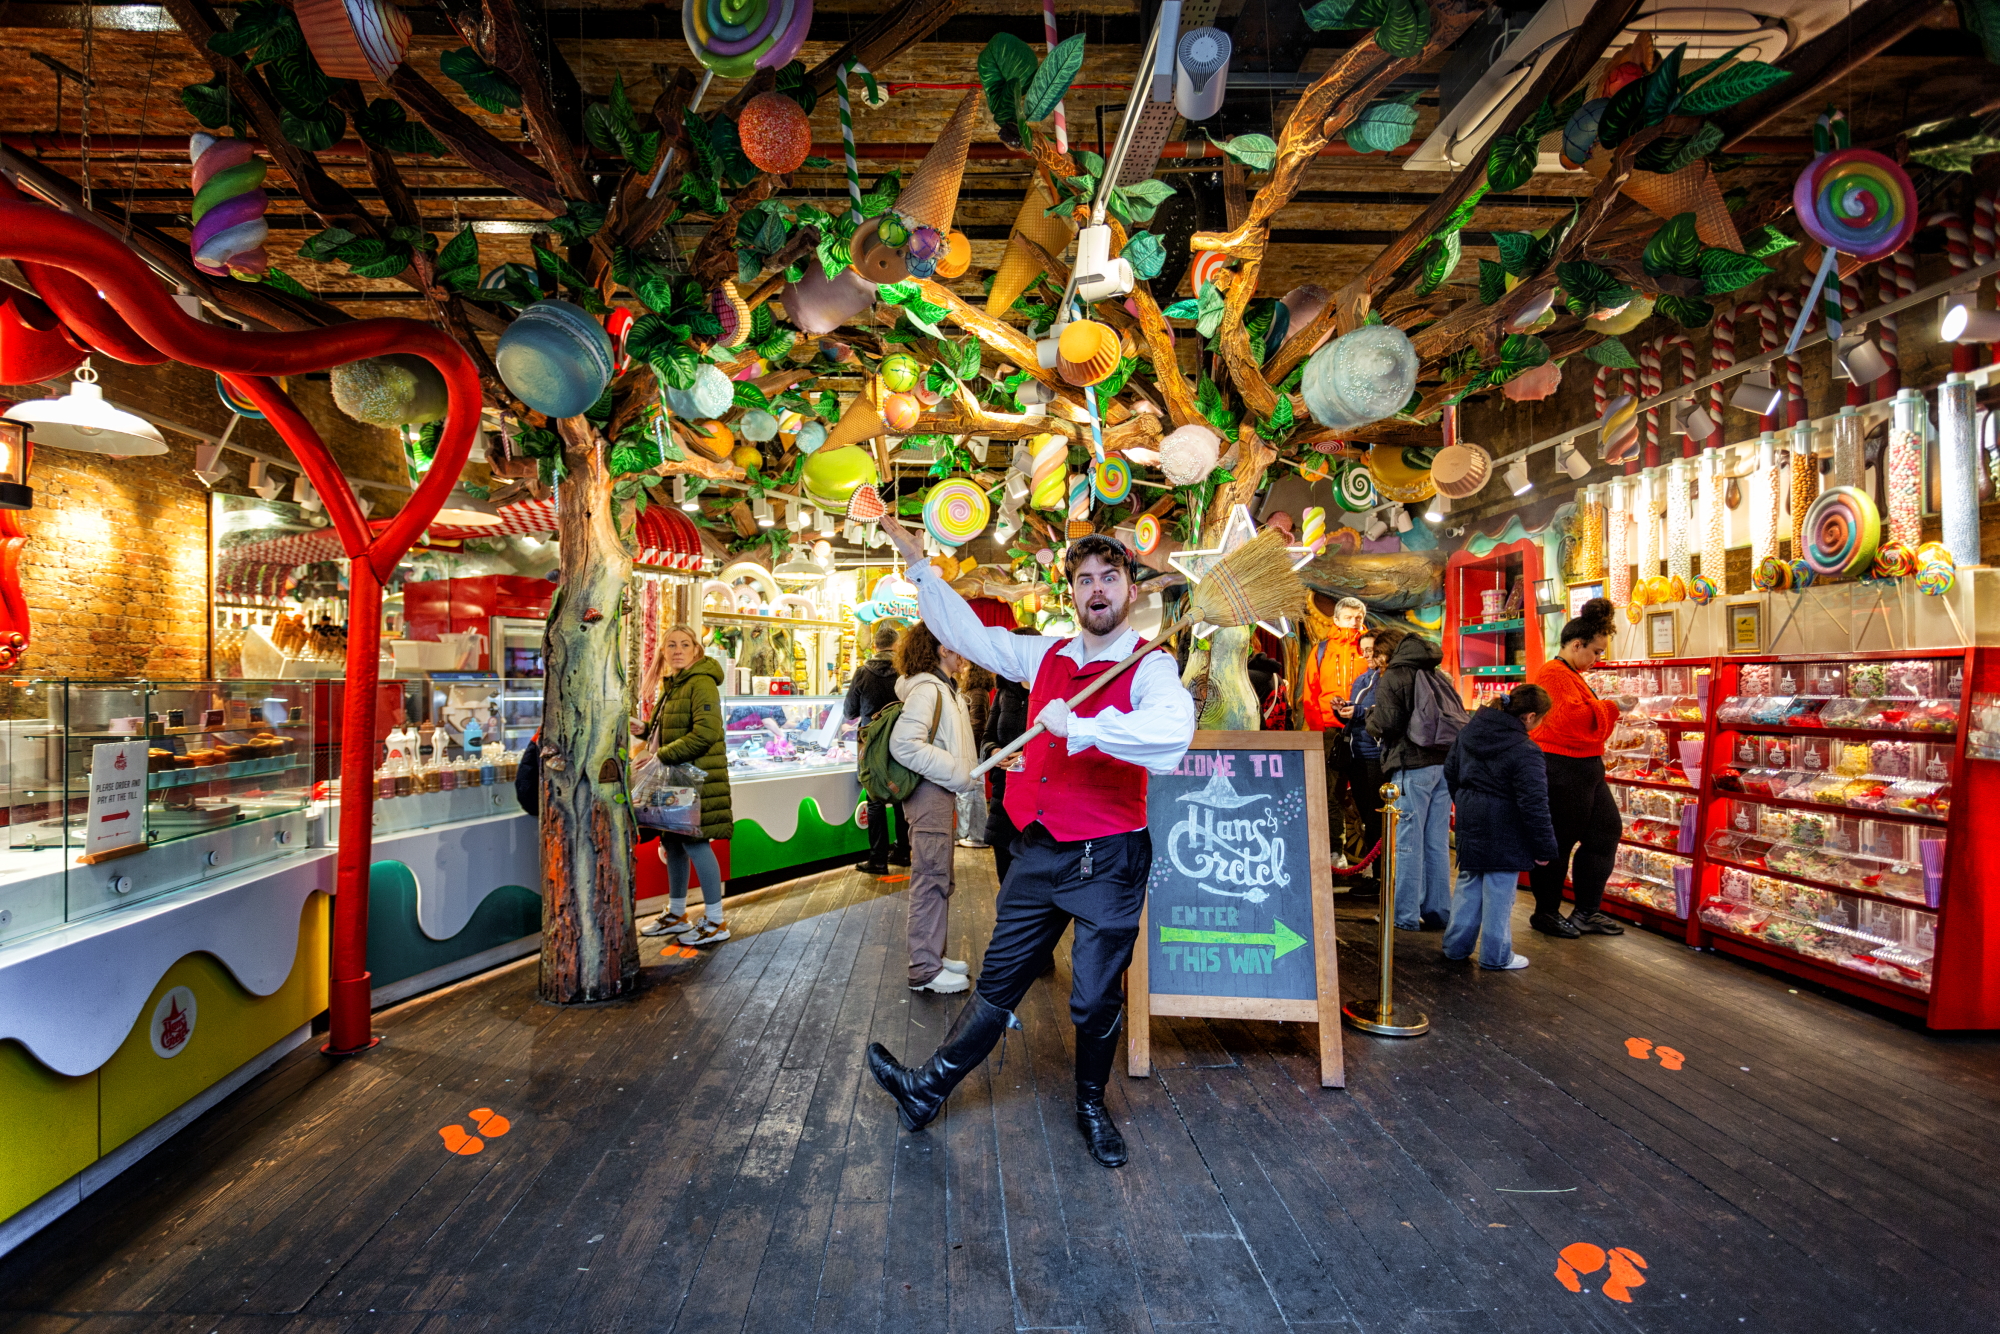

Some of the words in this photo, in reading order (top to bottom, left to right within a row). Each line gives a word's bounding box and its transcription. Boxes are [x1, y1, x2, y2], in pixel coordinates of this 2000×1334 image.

[1150, 755, 1236, 777] LCOME
[1249, 754, 1284, 778] TO
[96, 782, 114, 793] PLEASE
[115, 780, 131, 790] ORDER
[131, 779, 141, 788] AND
[97, 796, 108, 805] PAY
[108, 794, 116, 803] AT
[117, 792, 127, 801] THE
[127, 791, 138, 799] TILL
[1187, 804, 1271, 862] Hans
[1264, 808, 1278, 833] &
[1168, 820, 1290, 888] Gretel
[1171, 906, 1239, 926] ENTER
[1161, 946, 1221, 973] THIS
[1228, 947, 1275, 974] WAY
